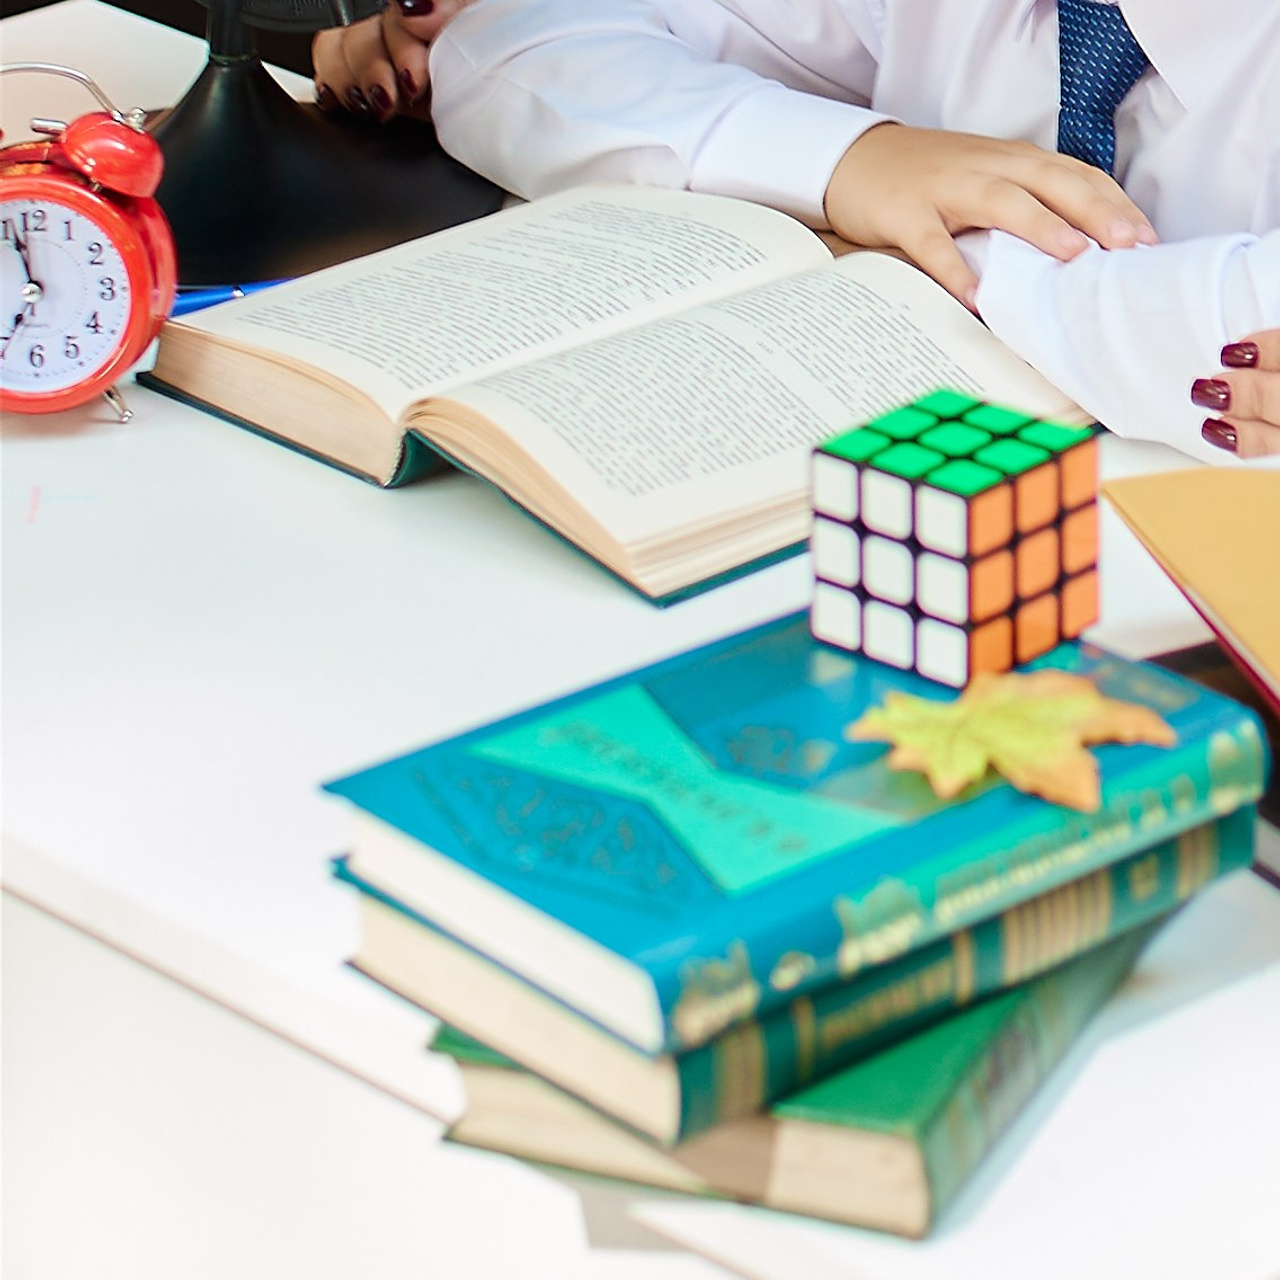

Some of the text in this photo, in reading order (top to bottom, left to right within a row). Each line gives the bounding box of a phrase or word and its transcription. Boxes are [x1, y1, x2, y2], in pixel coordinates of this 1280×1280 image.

[21, 209, 48, 232] 12
[64, 220, 74, 241] 1
[89, 242, 104, 265] 2
[100, 277, 117, 301] 3
[86, 311, 104, 334] 4
[29, 344, 45, 368] 6
[65, 336, 80, 359] 5
